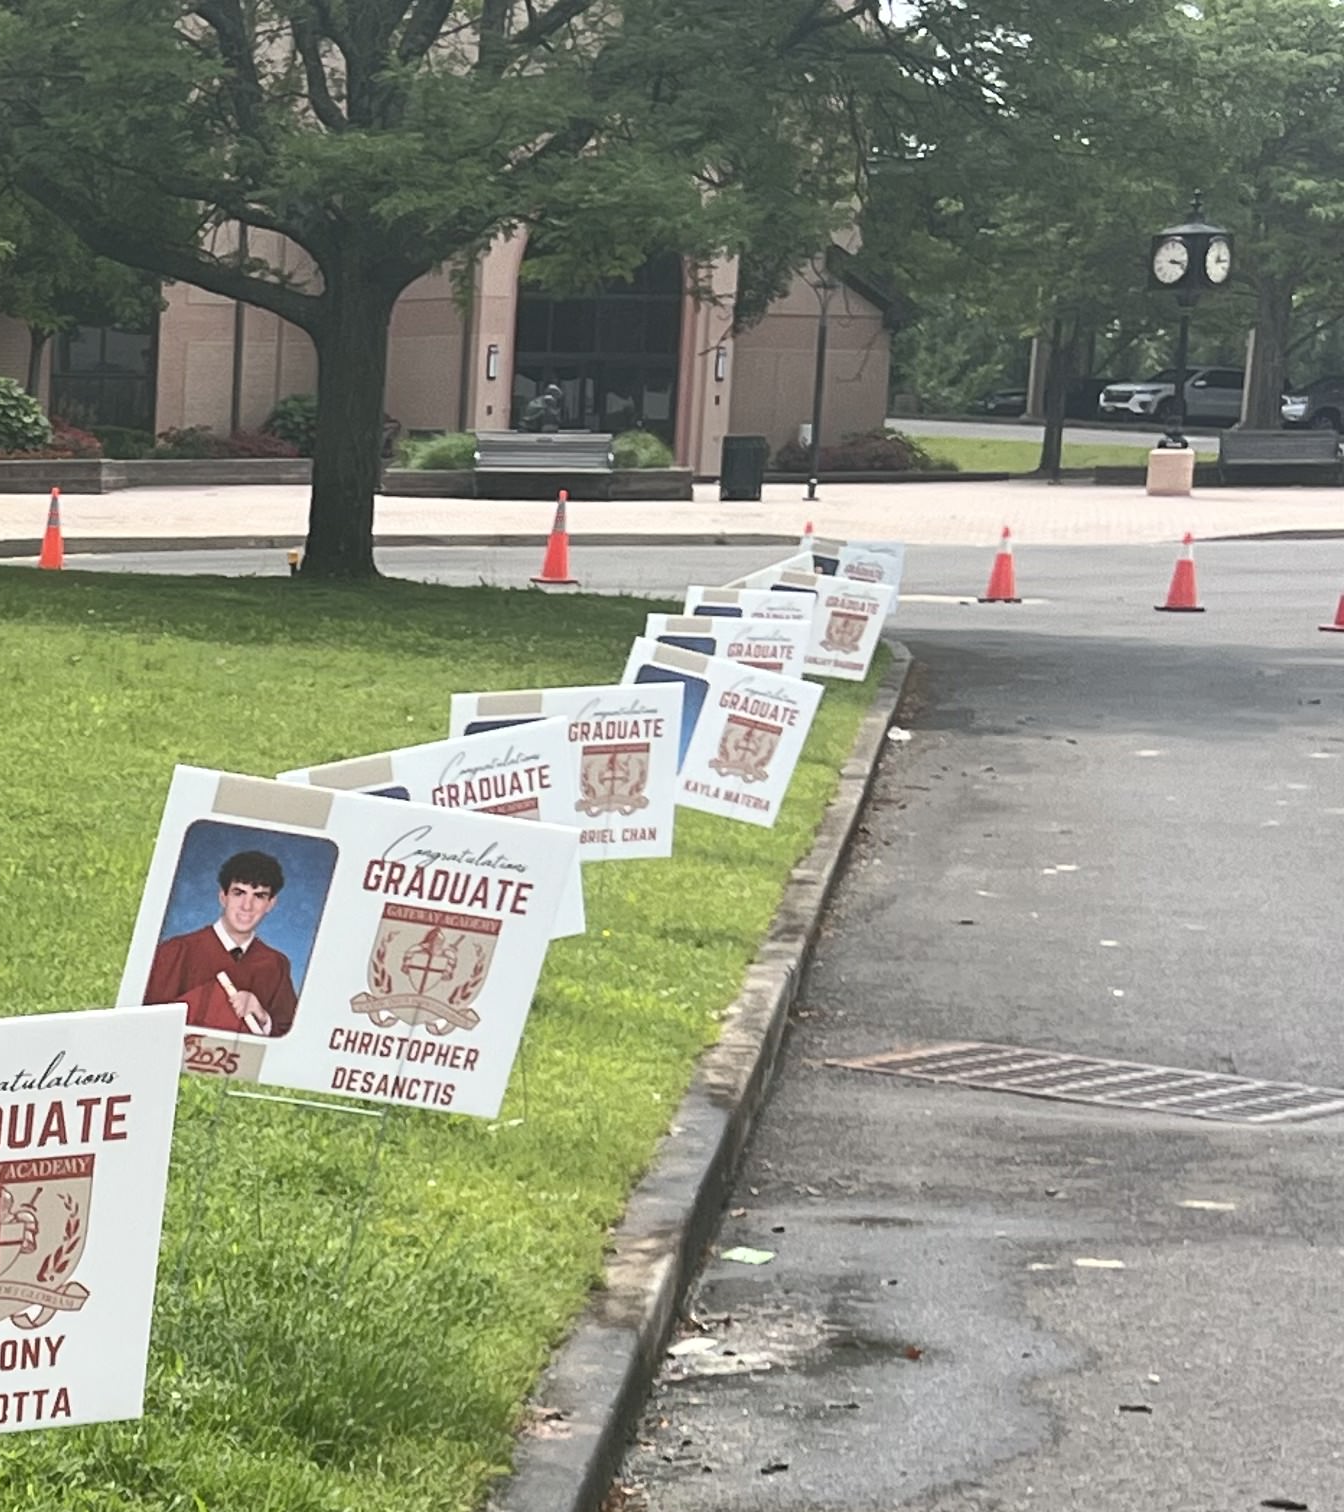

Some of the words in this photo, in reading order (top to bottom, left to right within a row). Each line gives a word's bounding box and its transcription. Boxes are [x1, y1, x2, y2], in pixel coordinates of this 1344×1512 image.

[719, 691, 800, 726] GRADUATE
[568, 718, 665, 742] GRADUATE
[432, 764, 552, 808] GRADUATE
[684, 780, 721, 799] KAYLA
[579, 829, 616, 844] BRIEL
[622, 827, 657, 842] CHAN
[362, 859, 534, 915] GRADUATE
[386, 904, 442, 923] GATEWAY
[185, 1045, 241, 1074] 2025
[328, 1027, 480, 1071] CHRISTOPHER
[331, 1066, 456, 1106] DESANCTIS
[7, 1156, 91, 1180] ACADEMY
